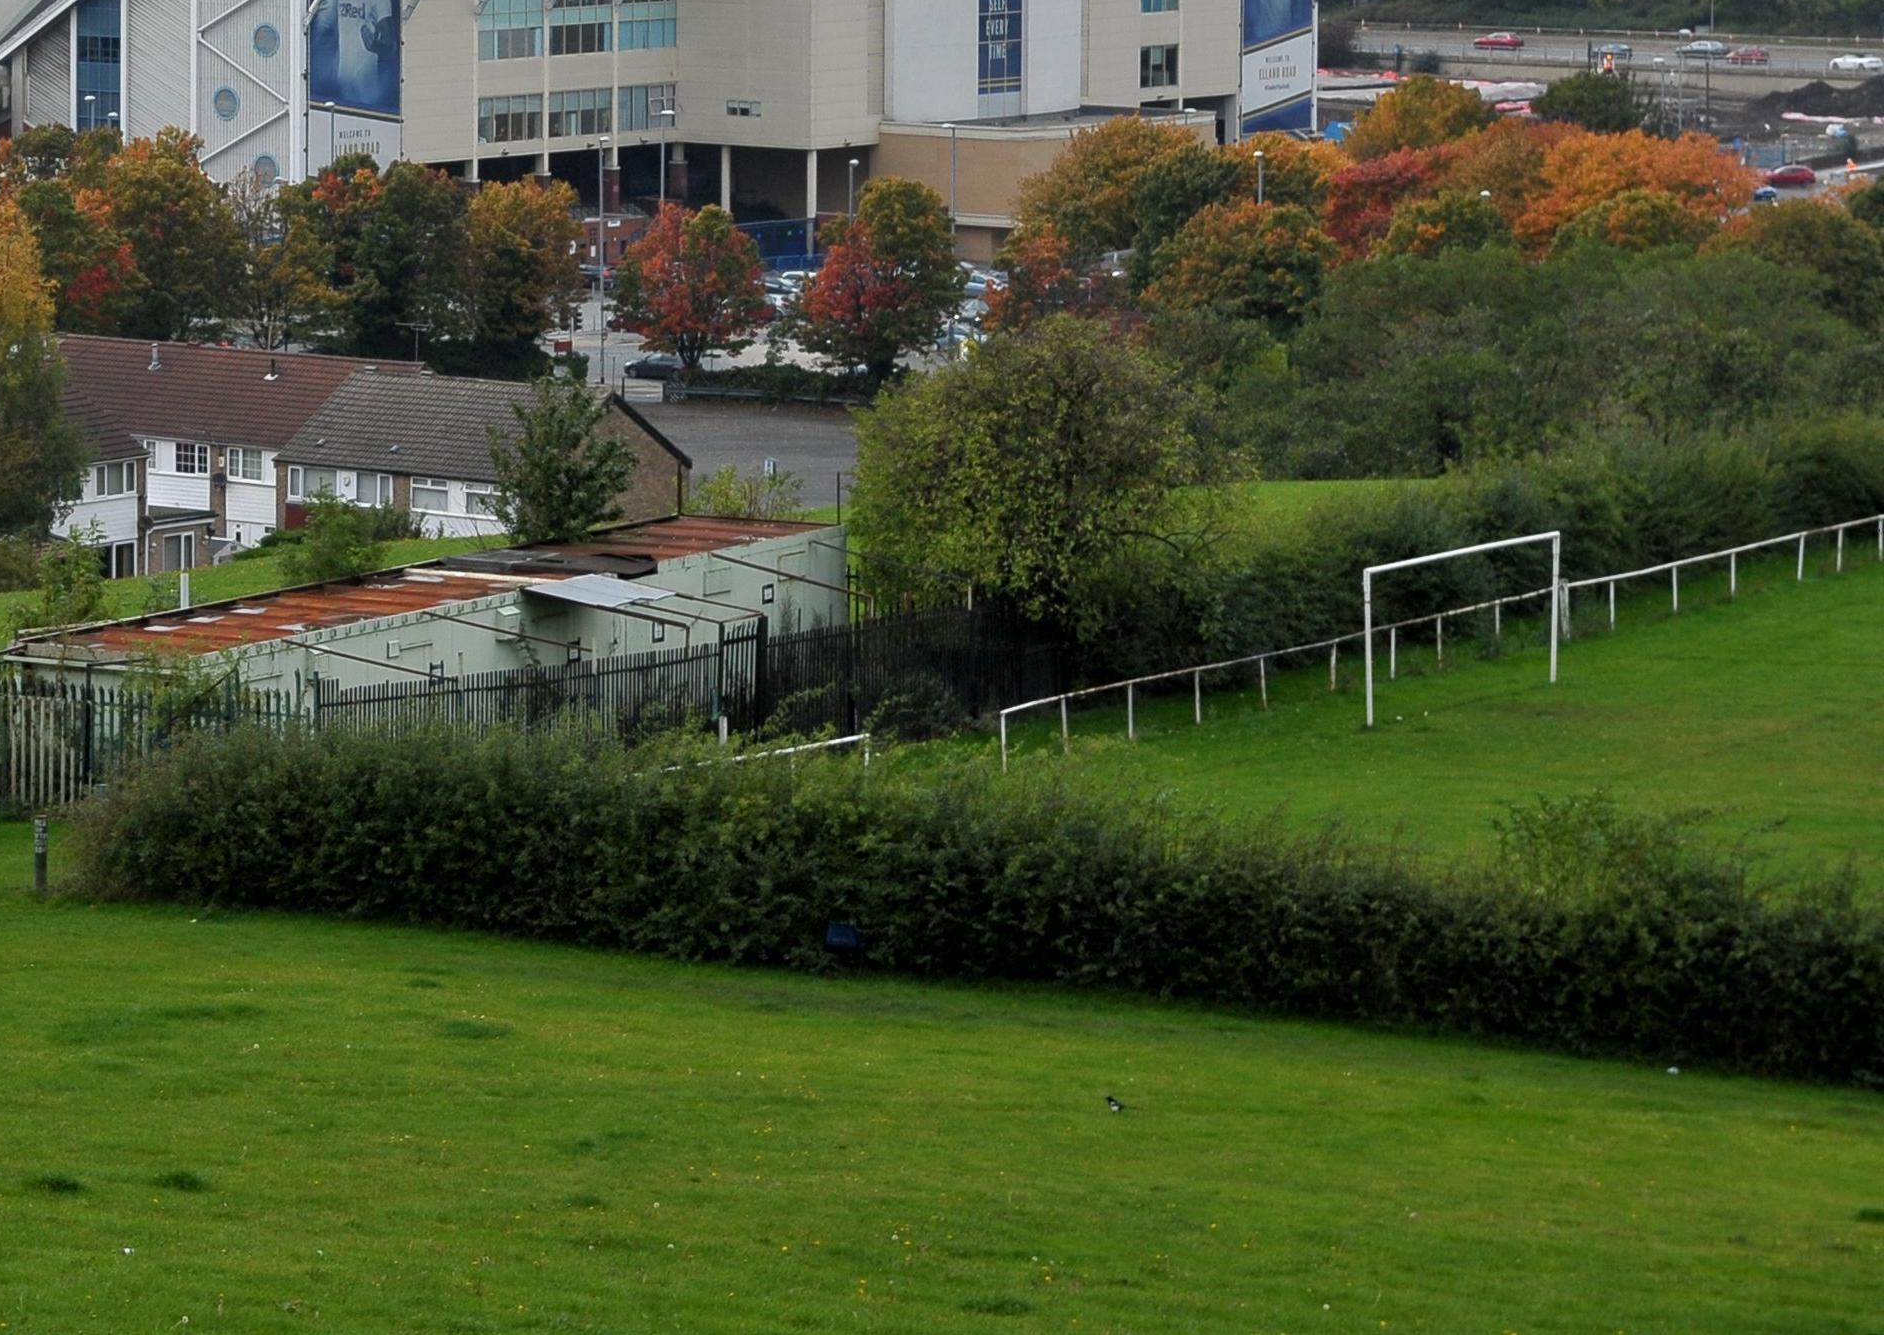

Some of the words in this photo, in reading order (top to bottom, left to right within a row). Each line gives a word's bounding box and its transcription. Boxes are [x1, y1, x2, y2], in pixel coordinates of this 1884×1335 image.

[986, 19, 1009, 36] EVERY
[988, 42, 1007, 60] TIME
[1259, 67, 1280, 80] ELLAND
[1282, 65, 1296, 78] ROAD
[339, 129, 363, 139] WELCOME
[360, 141, 380, 154] ROAD
